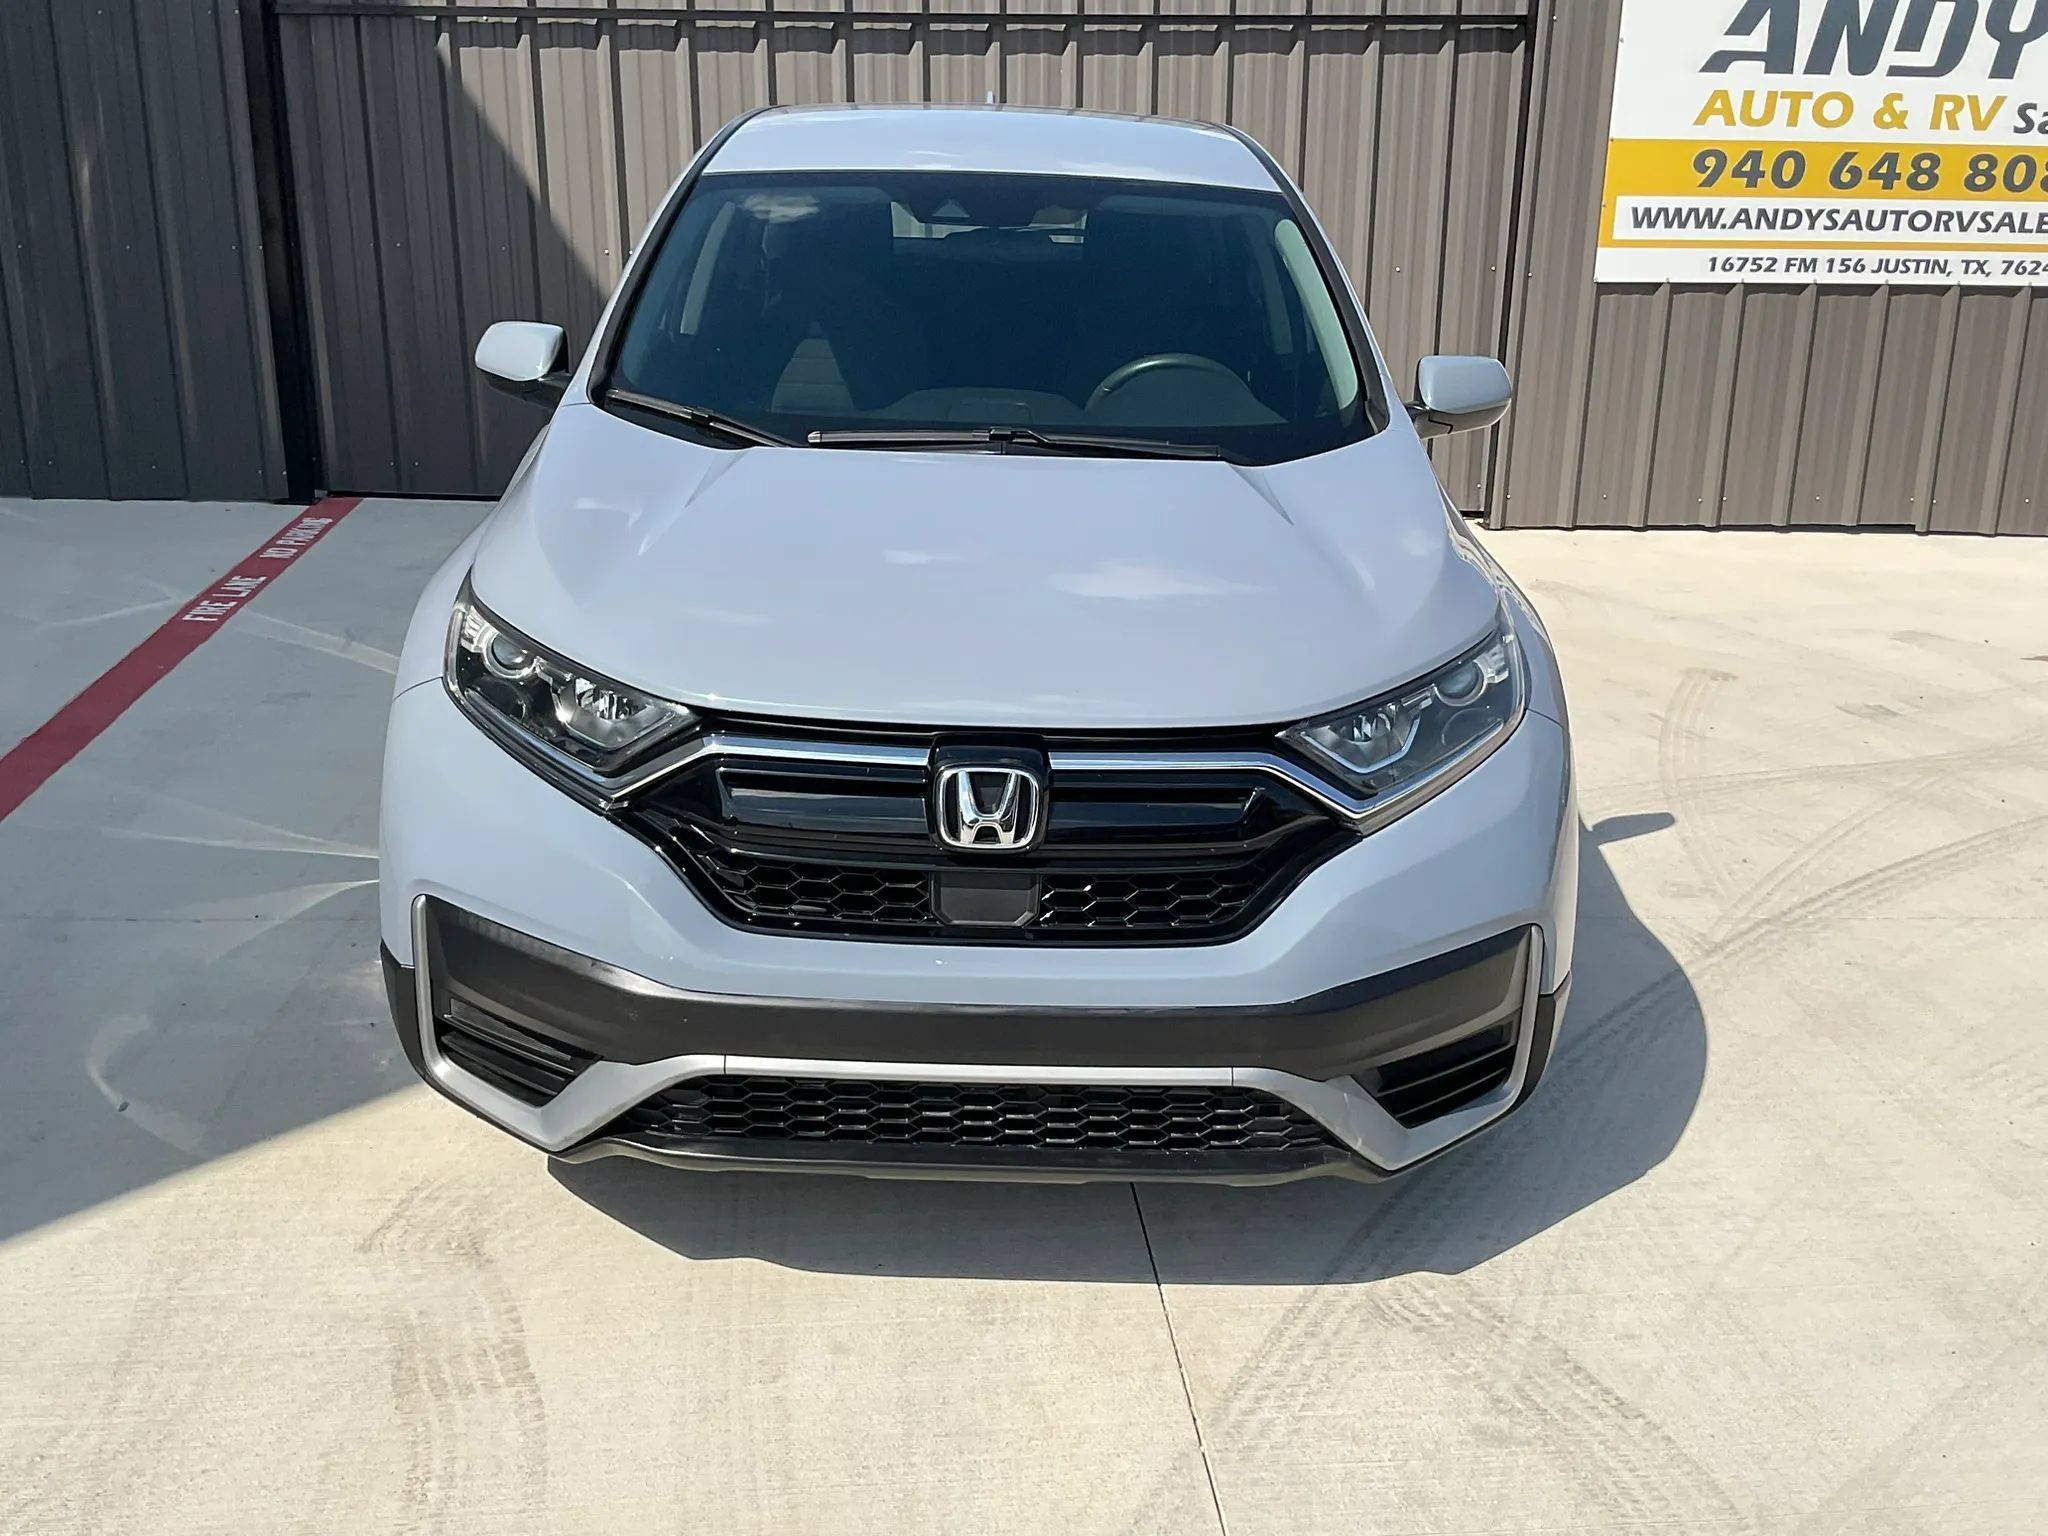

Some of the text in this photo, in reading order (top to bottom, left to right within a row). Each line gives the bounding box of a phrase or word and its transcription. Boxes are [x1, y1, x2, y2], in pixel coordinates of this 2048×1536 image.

[1693, 90, 1854, 128] AUTO
[1873, 93, 1908, 130] &
[1930, 94, 2007, 130] RV
[1693, 149, 2048, 193] 940 648 80
[1709, 256, 1778, 273] 16752
[1784, 257, 1818, 273] FM
[1826, 258, 1866, 274] 156
[1871, 258, 1952, 277] JUSTIN,
[1961, 259, 1992, 277] TX,
[182, 600, 237, 622] FIRE
[212, 575, 267, 597] LANE
[260, 547, 298, 559] NO
